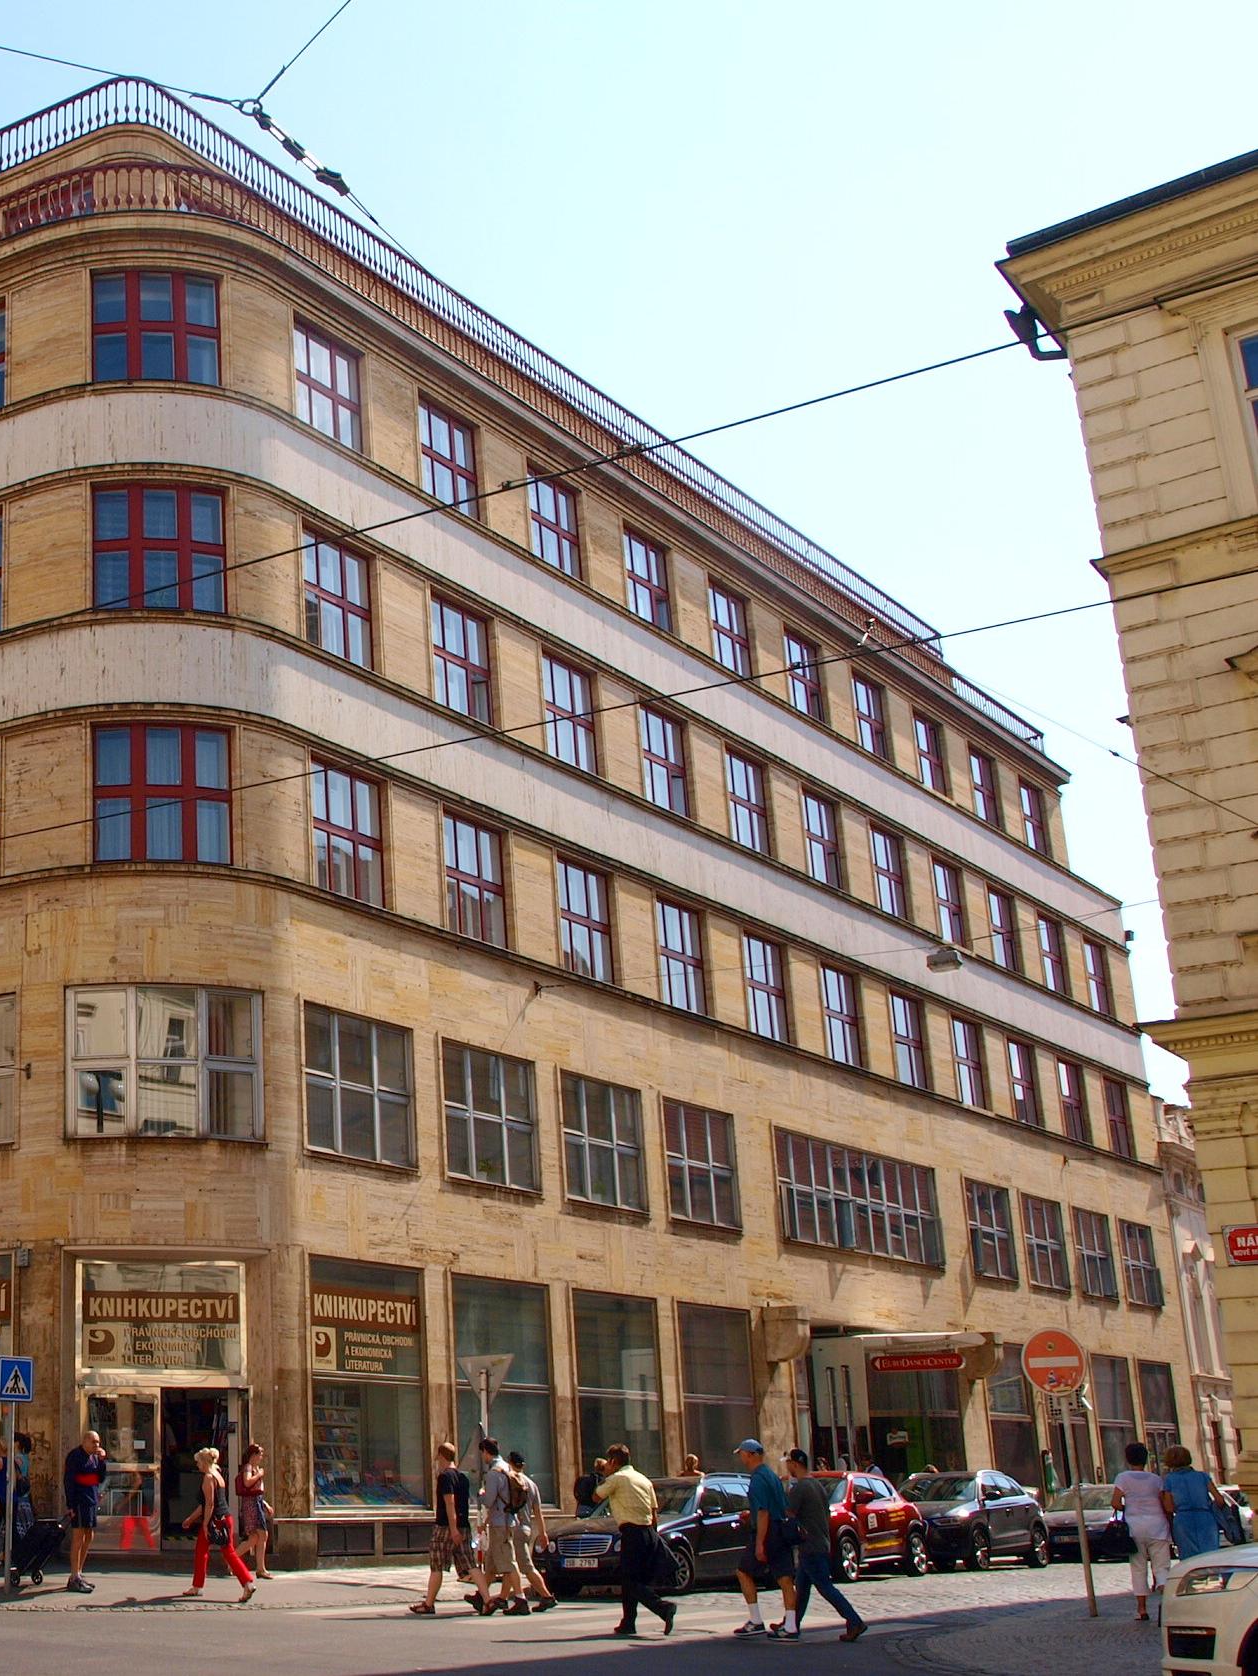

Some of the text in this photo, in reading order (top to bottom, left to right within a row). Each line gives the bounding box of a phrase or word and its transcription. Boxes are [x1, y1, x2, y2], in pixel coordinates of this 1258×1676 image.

[89, 1295, 234, 1319] KNIHKUPECTVÍ
[313, 1293, 416, 1326] KNIHKUPECTVÍ
[124, 1342, 132, 1351] A
[345, 1346, 350, 1356] A
[124, 1354, 184, 1365] LITERATURA
[345, 1359, 383, 1372] LITERATURA
